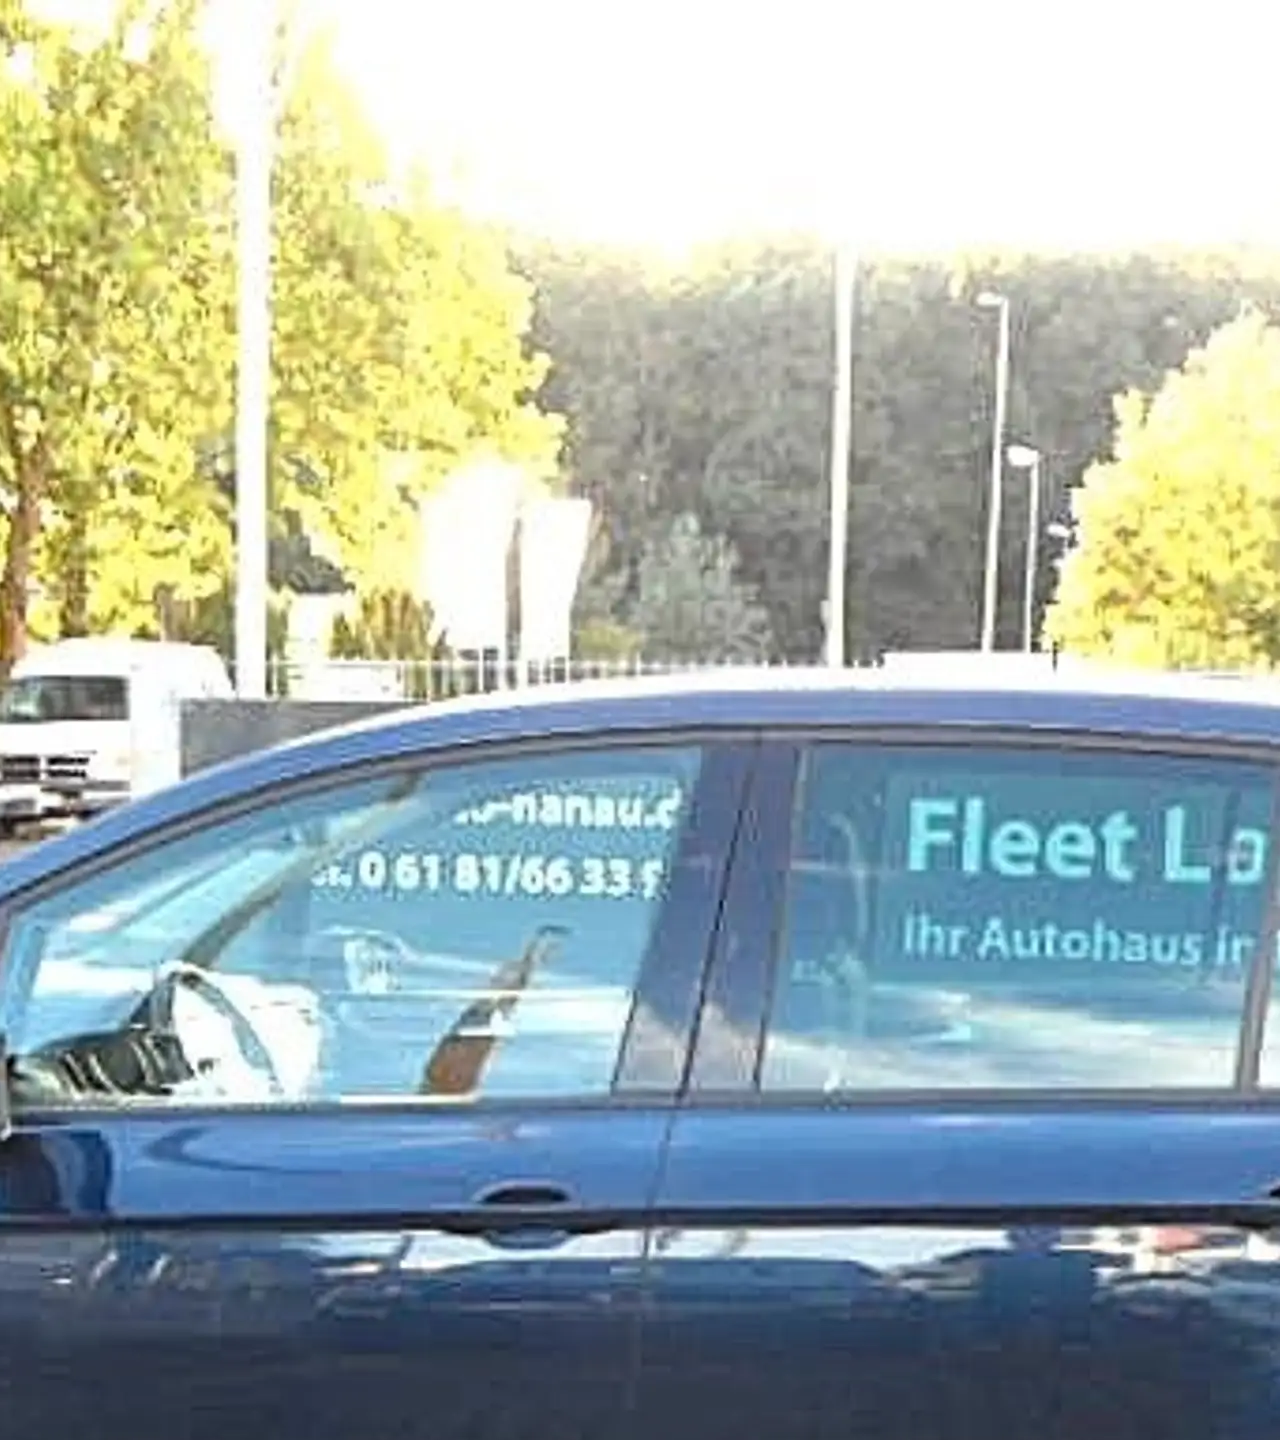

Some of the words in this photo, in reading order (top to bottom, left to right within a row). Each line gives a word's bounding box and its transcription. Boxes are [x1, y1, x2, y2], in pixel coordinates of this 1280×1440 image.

[907, 796, 1138, 882] Fleet
[904, 909, 968, 958] Ihr
[977, 917, 1203, 967] Autohaus
